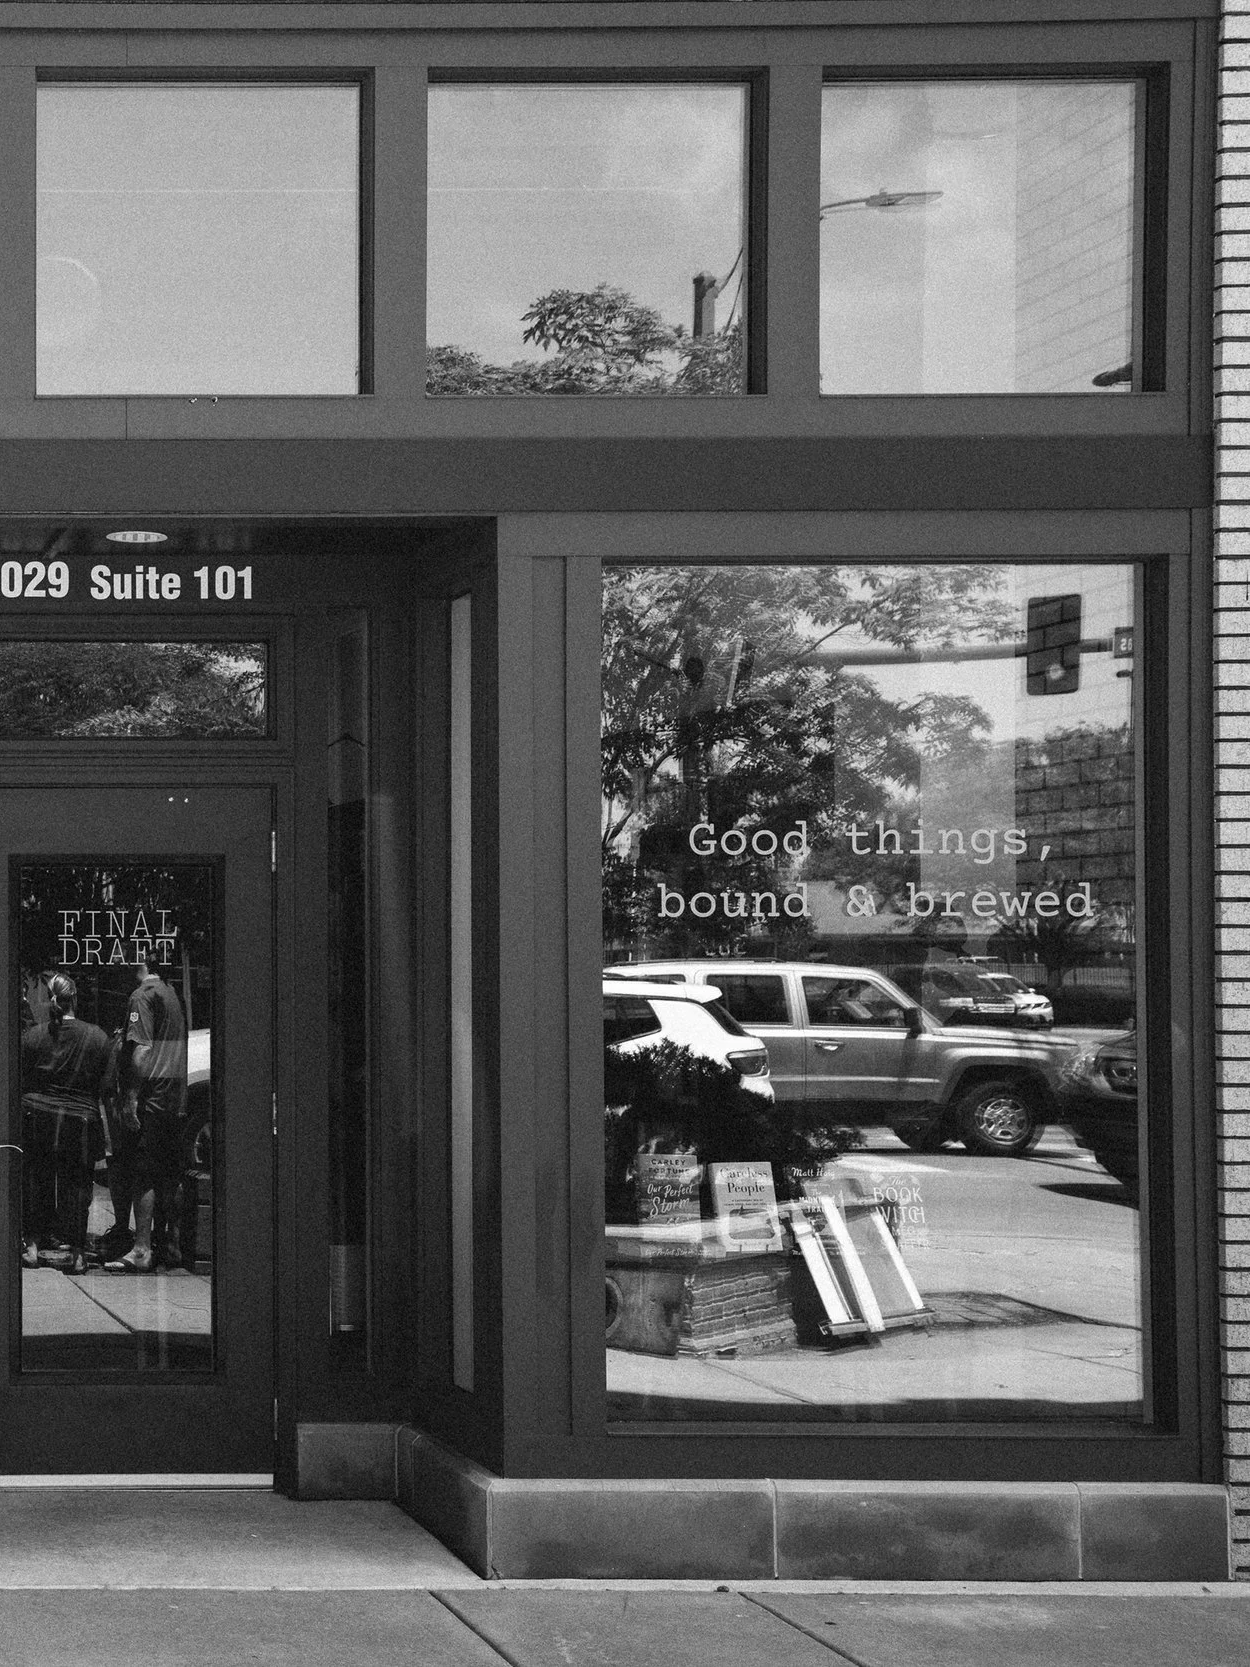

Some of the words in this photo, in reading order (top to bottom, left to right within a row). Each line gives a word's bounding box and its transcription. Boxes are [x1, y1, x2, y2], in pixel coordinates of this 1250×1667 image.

[90, 564, 181, 600] Suite
[194, 565, 252, 600] 101
[688, 820, 808, 856] Good
[845, 820, 1052, 864] things,
[657, 882, 812, 918] bound
[845, 885, 876, 918] &
[907, 882, 1095, 918] brewed
[57, 909, 178, 938] FINAL
[58, 938, 175, 965] DRAFT
[791, 1167, 814, 1177] Matt
[727, 1181, 766, 1196] People
[873, 1187, 923, 1203] BOOK
[650, 1196, 690, 1218] Storm
[875, 1206, 926, 1223] WITCH
